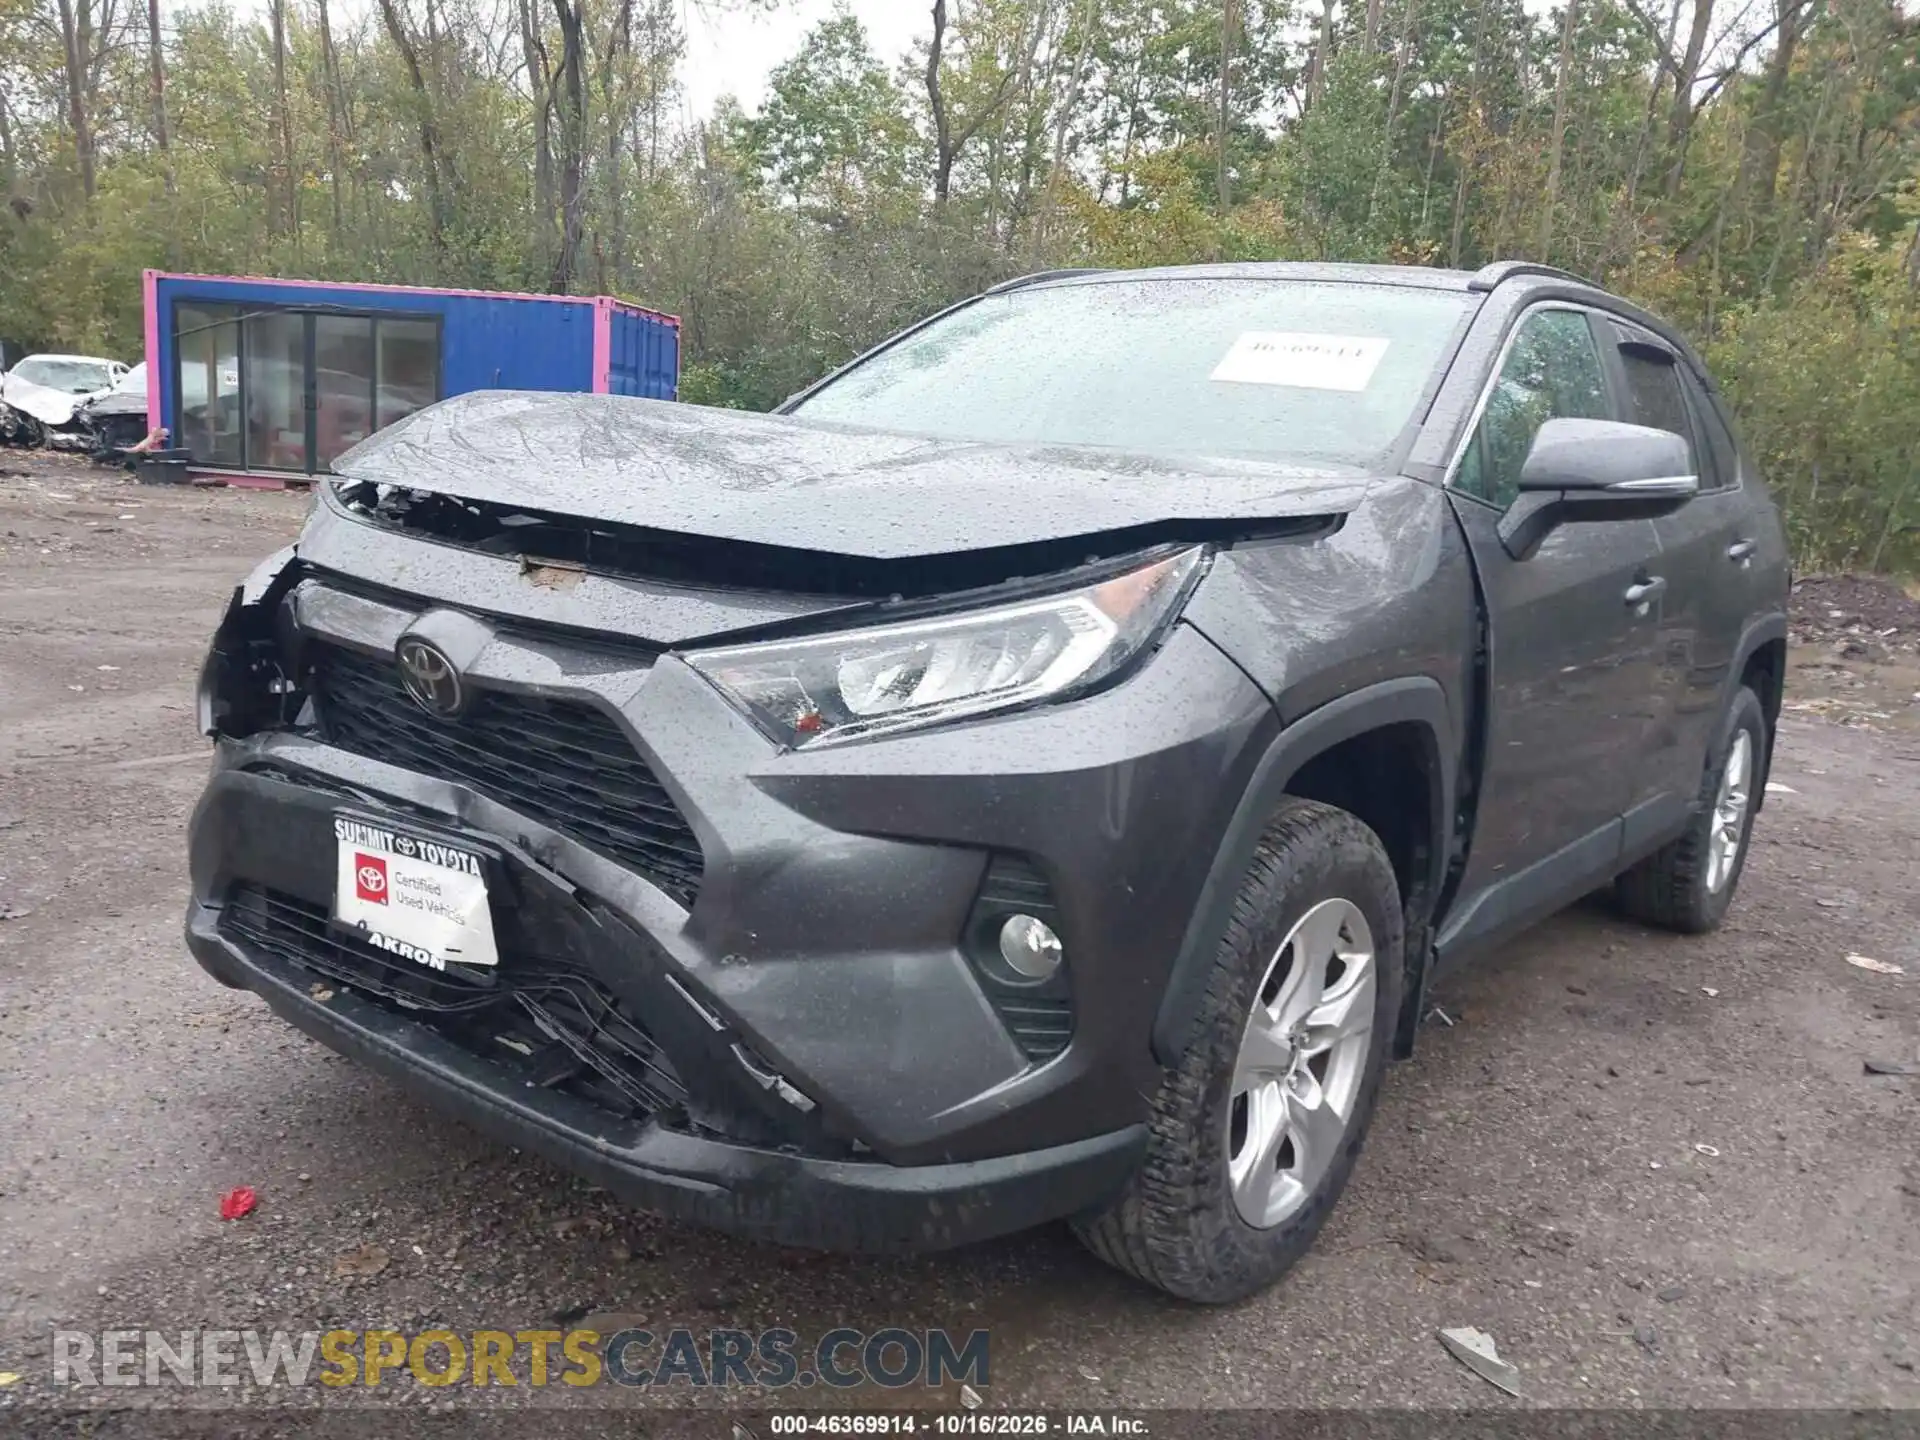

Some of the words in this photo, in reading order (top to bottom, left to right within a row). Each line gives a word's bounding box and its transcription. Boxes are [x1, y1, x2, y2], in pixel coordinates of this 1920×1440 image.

[334, 818, 395, 853] SUMMIT
[416, 840, 481, 877] TOYOTA
[395, 871, 442, 897] Certified
[396, 890, 424, 910] Used
[368, 931, 446, 972] AKRON
